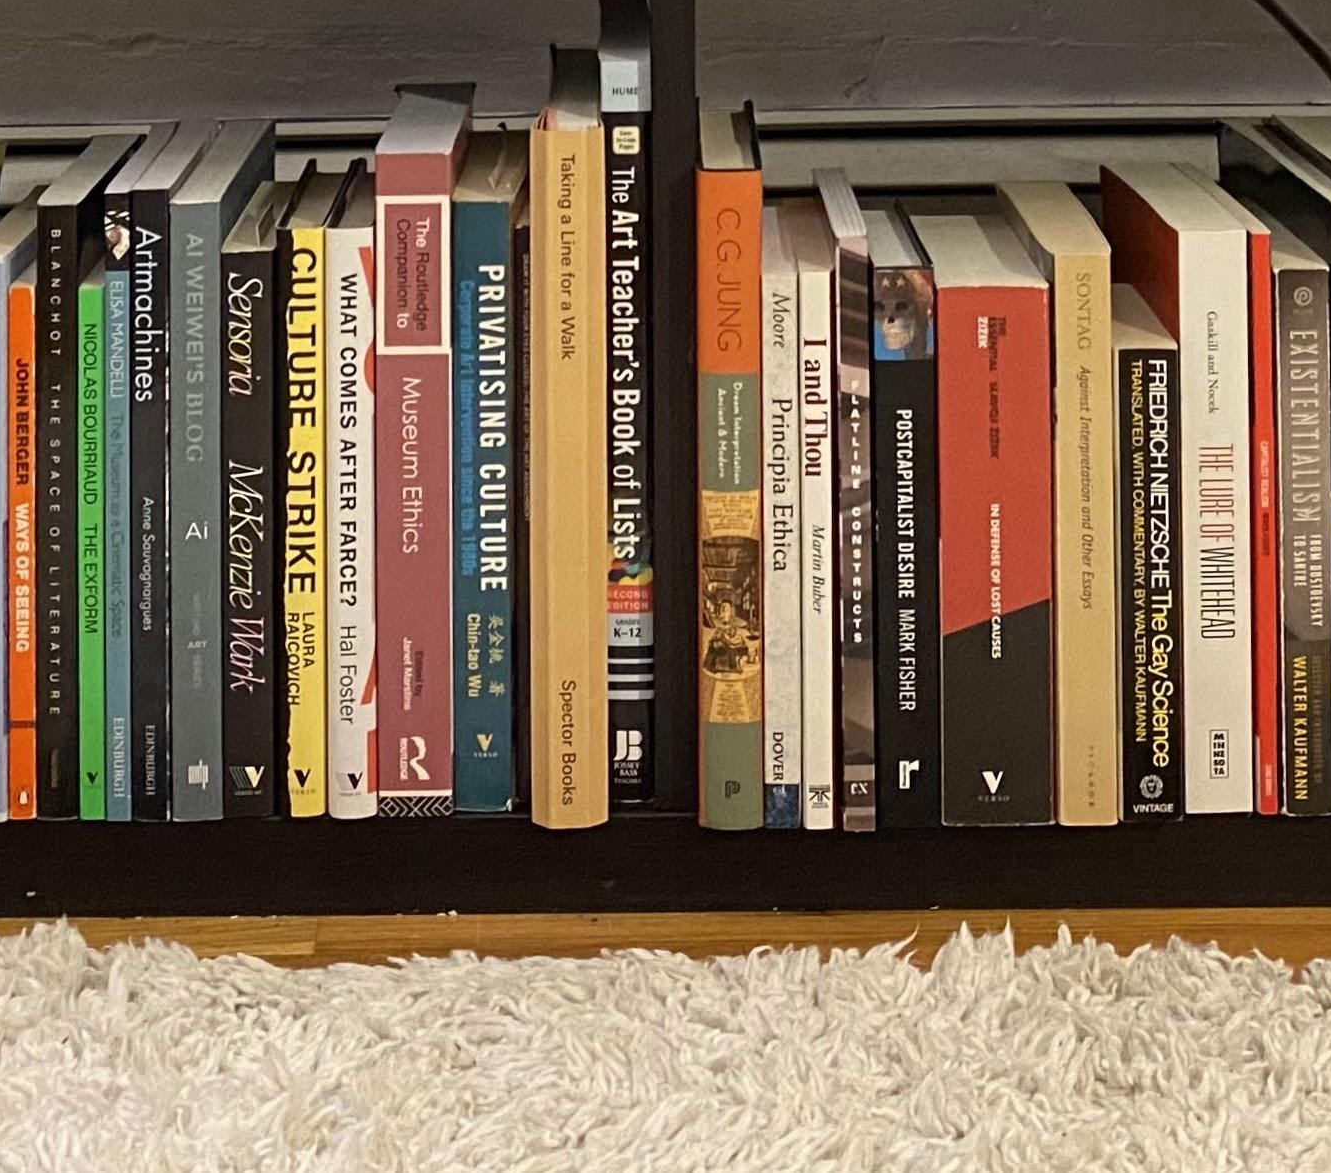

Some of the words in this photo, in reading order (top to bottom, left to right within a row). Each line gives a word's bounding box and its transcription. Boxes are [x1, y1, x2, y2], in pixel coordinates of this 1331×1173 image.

[612, 166, 635, 203] The
[612, 210, 638, 250] Art
[135, 226, 163, 402] Artmachines
[228, 273, 263, 395] Sensoria
[287, 249, 316, 428] CULTURE
[340, 274, 357, 337] WHAT
[613, 255, 640, 382] Teacher's
[478, 265, 506, 448] PRIVATISING
[803, 338, 827, 347] I
[340, 348, 357, 429] COMES
[804, 360, 828, 405] and
[1149, 359, 1168, 469] FRIEDRICH
[612, 388, 641, 457] Book
[804, 412, 828, 476] Thou
[1289, 330, 1320, 522] EXISTENTIALISM
[340, 439, 357, 511] AFTER
[613, 461, 641, 490] of
[896, 409, 914, 536] POSTCAPITALIST
[229, 460, 265, 609] McKenzie
[286, 451, 316, 593] STRIKE
[480, 464, 507, 590] CULTURE
[613, 496, 642, 559] Lists
[1149, 472, 1170, 588] NIETZSCHE
[339, 521, 357, 607] FARCE?
[897, 543, 915, 598] DESIRE
[339, 626, 357, 656] Hal
[899, 609, 915, 651] MARK
[1151, 590, 1173, 631] The
[230, 617, 265, 693] Wark
[899, 655, 916, 711] FISHER
[1148, 635, 1174, 678] Gay
[339, 663, 357, 724] Foster
[1152, 680, 1174, 768] Science
[772, 732, 784, 781] DOVER
[1133, 804, 1174, 813] VINTAGE
